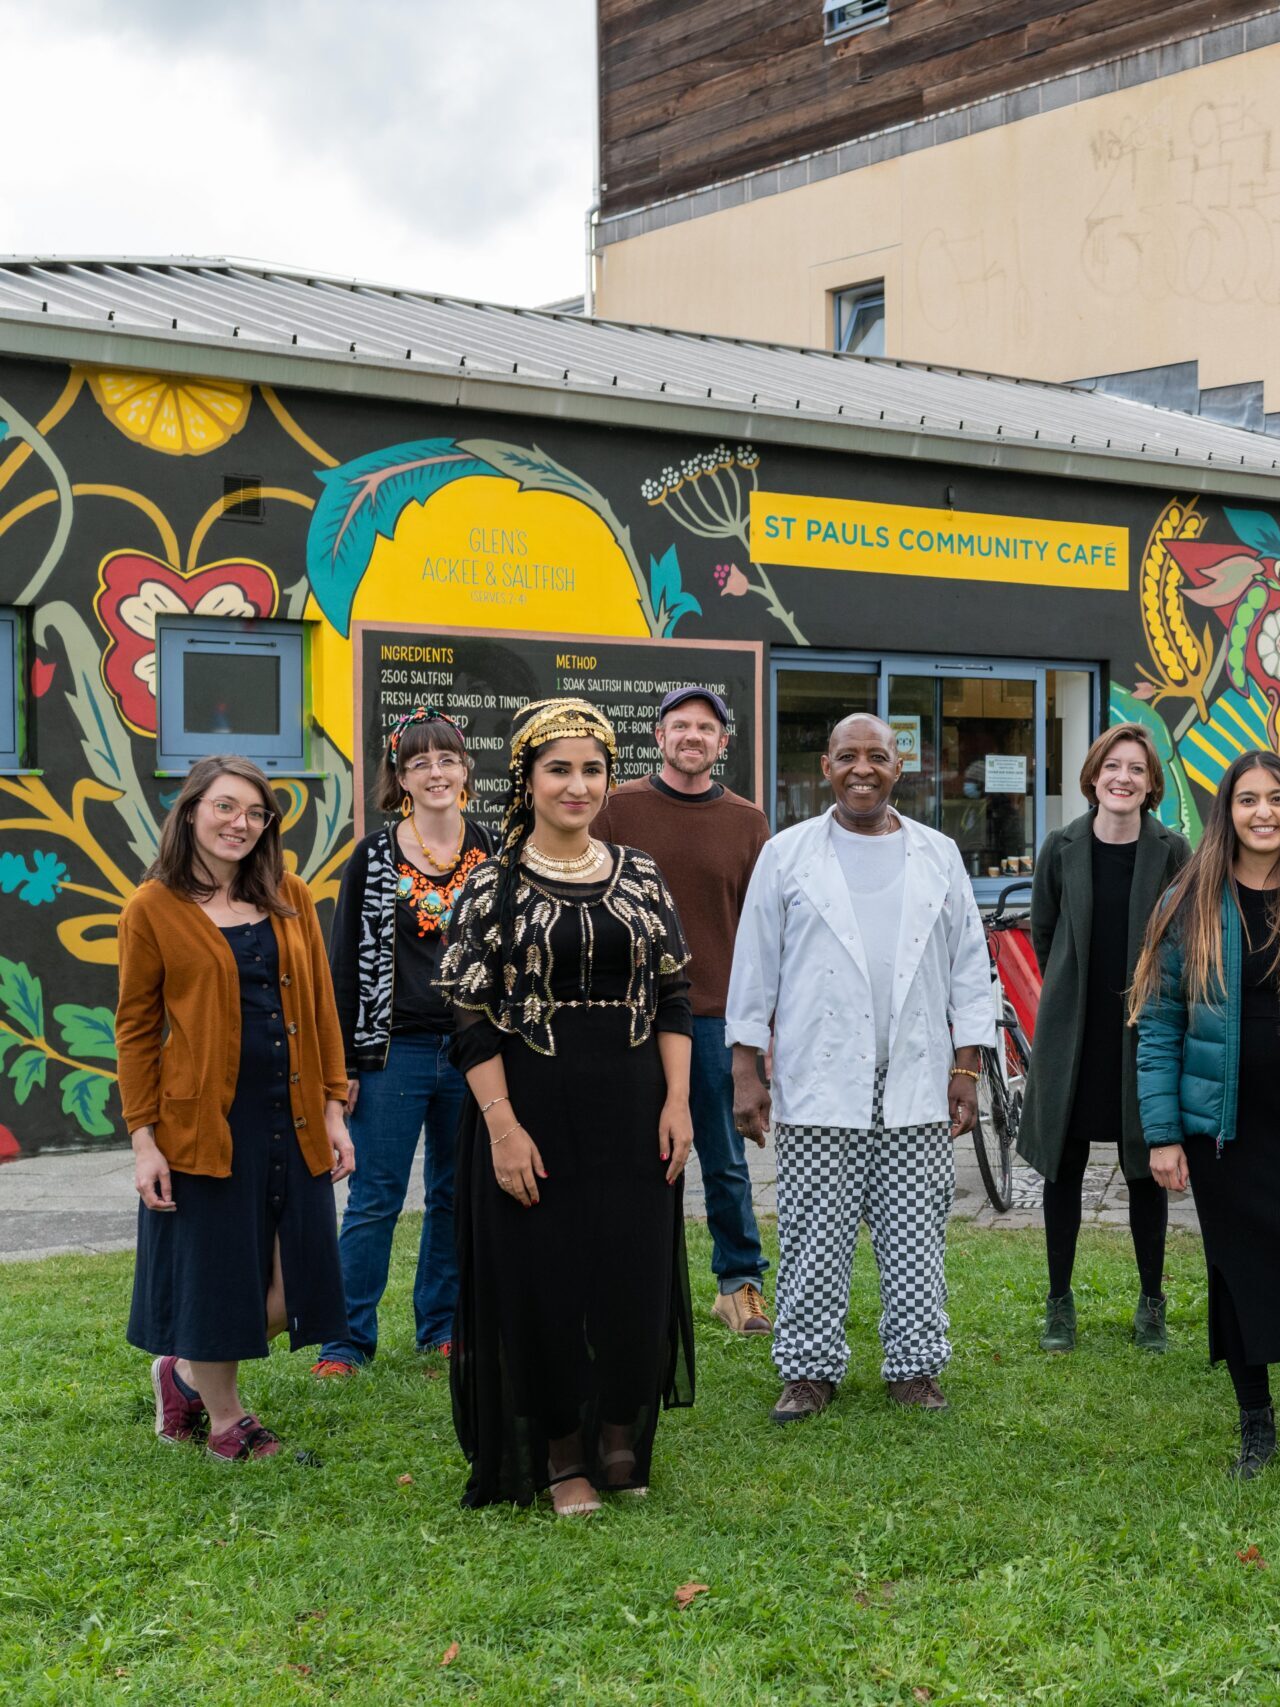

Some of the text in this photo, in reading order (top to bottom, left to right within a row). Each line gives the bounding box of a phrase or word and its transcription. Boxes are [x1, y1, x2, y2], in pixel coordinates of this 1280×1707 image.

[469, 527, 528, 556] GLEN'S
[764, 514, 1117, 567] ST PAULS COMMUNITY CAFÉ
[422, 557, 575, 592] ACKEE & SALTFISH
[381, 645, 454, 664] INGREDIENTS
[556, 654, 597, 670] METHOD
[381, 669, 453, 686] 250G SALTFISH
[563, 677, 586, 691] SOAK
[587, 678, 622, 692] SALTFISH
[623, 680, 632, 692] IN
[633, 680, 654, 693] COLD
[381, 691, 412, 706] FRESH
[413, 693, 444, 708] ACKEE
[484, 695, 496, 709] OR
[637, 705, 654, 718] ADD
[617, 720, 653, 734] DE-BONE
[463, 736, 504, 750] ULIENNED
[623, 762, 653, 775] SCOTCH
